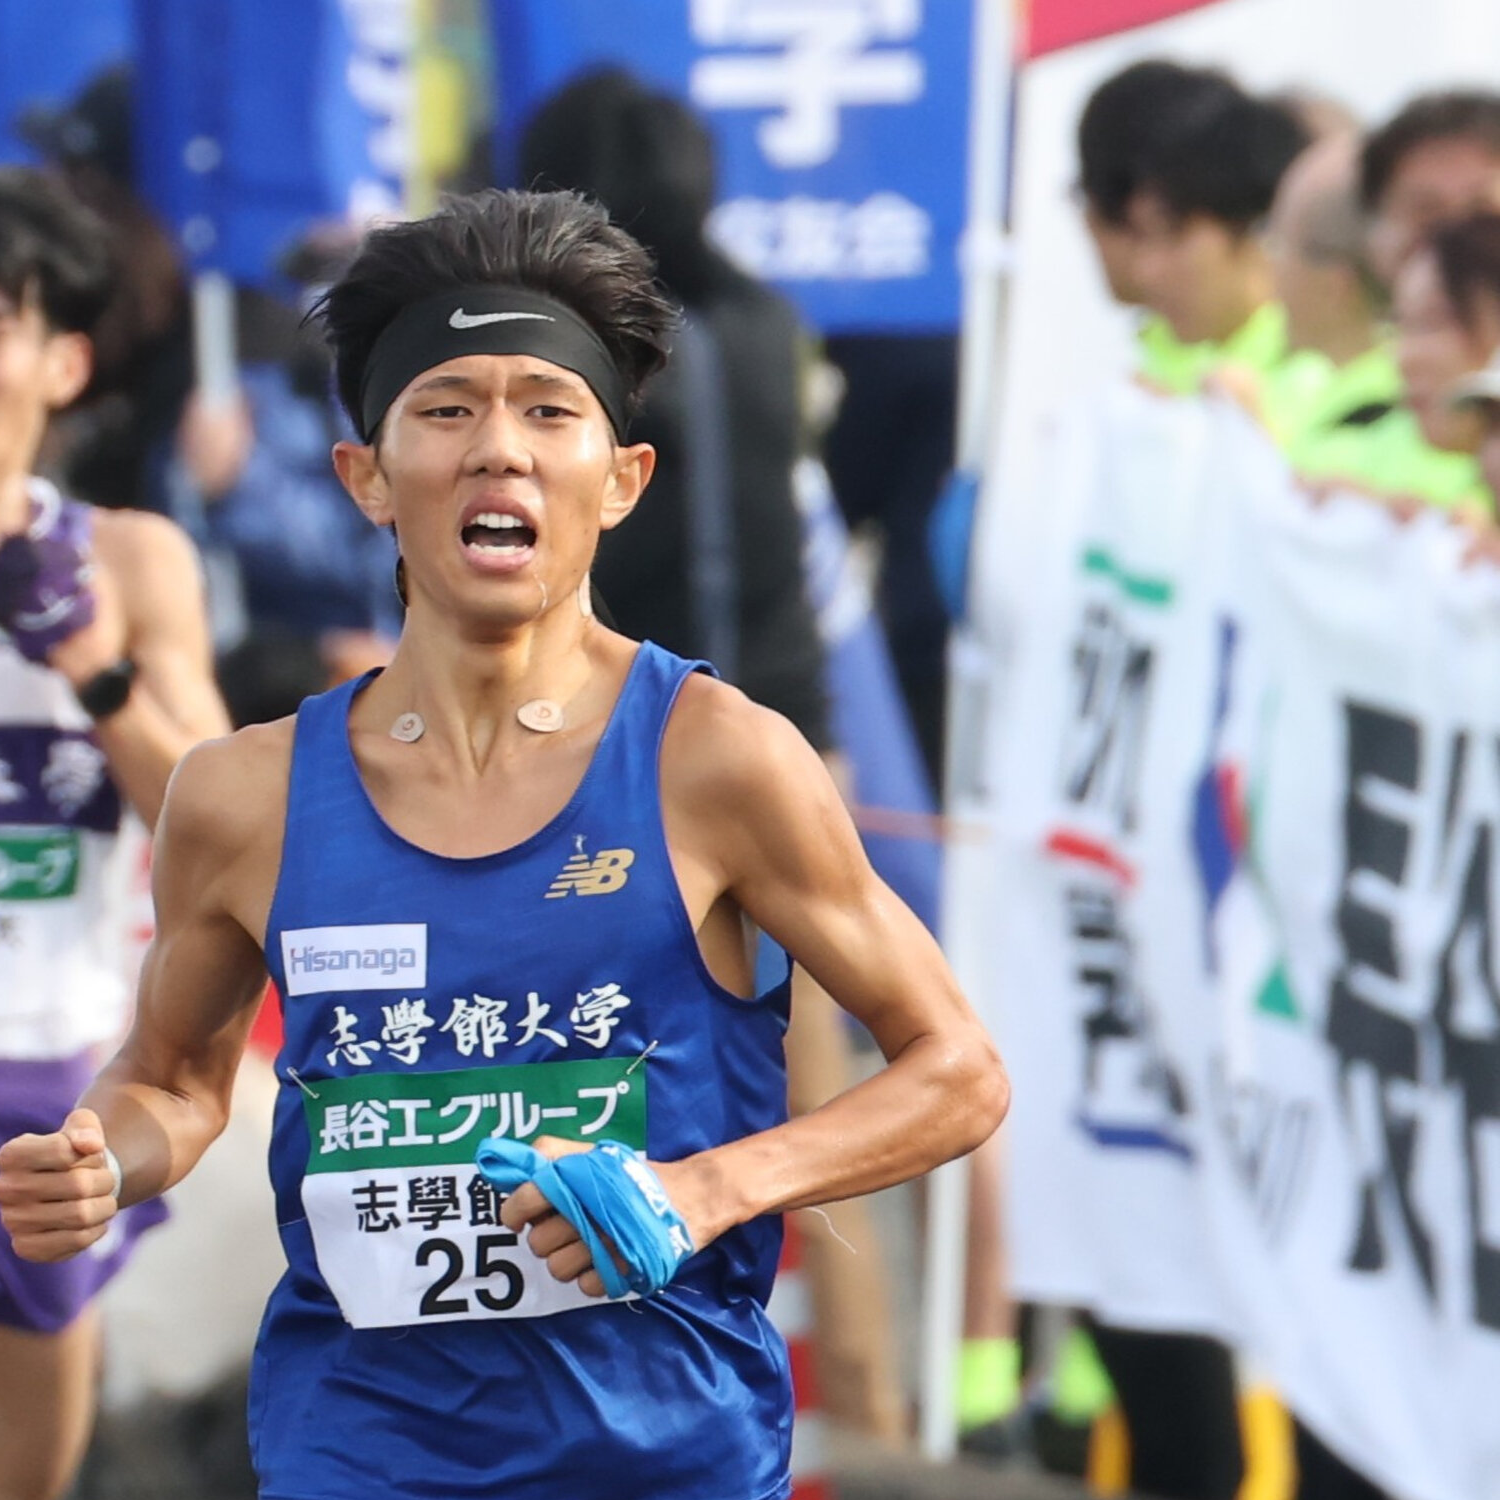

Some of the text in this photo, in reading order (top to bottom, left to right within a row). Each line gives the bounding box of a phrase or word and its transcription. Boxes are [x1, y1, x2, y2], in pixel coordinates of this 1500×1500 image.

[289, 945, 417, 976] Hisanaga
[325, 982, 631, 1067] 志學館大学
[319, 1080, 630, 1155] 長谷工グループ
[414, 1233, 525, 1317] 25
